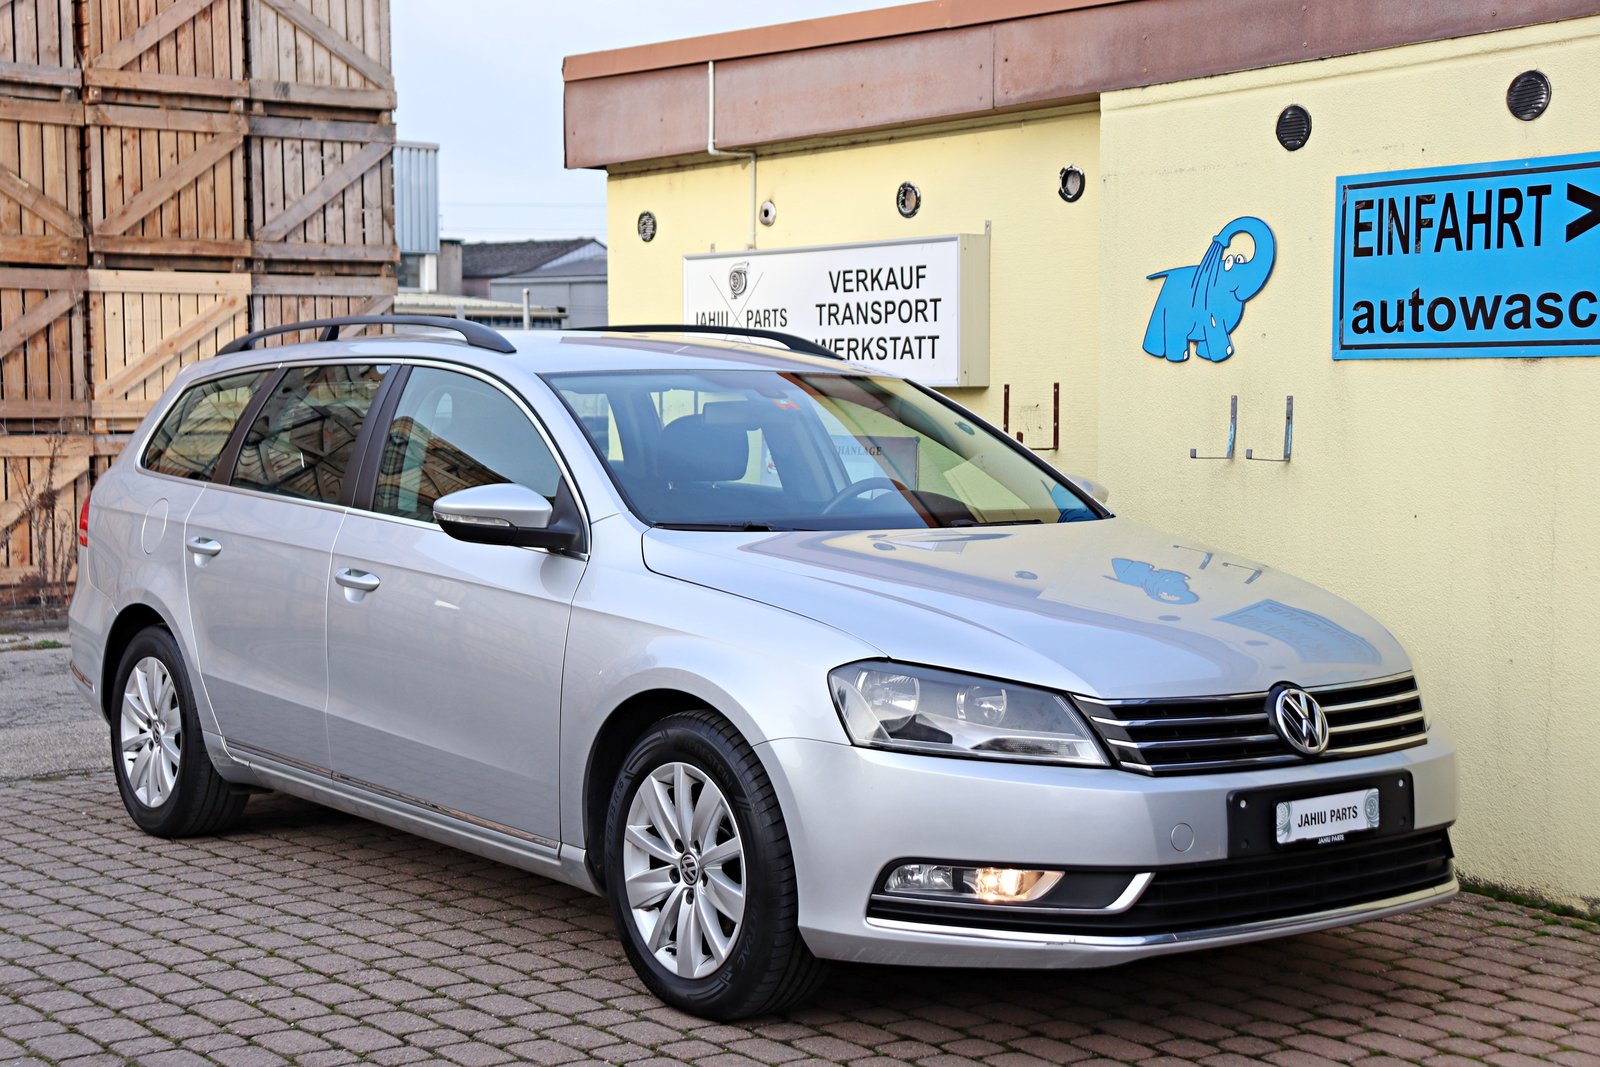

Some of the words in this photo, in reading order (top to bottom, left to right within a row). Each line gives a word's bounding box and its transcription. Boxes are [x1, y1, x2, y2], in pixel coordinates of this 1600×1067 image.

[1353, 184, 1552, 258] EINFAHRT
[829, 265, 927, 294] VERKAUF
[746, 308, 788, 328] PARTS
[815, 298, 942, 326] TRANSPORT
[1352, 287, 1598, 335] autowasc
[1298, 811, 1326, 828] JAHIU
[1330, 805, 1358, 823] PARTS
